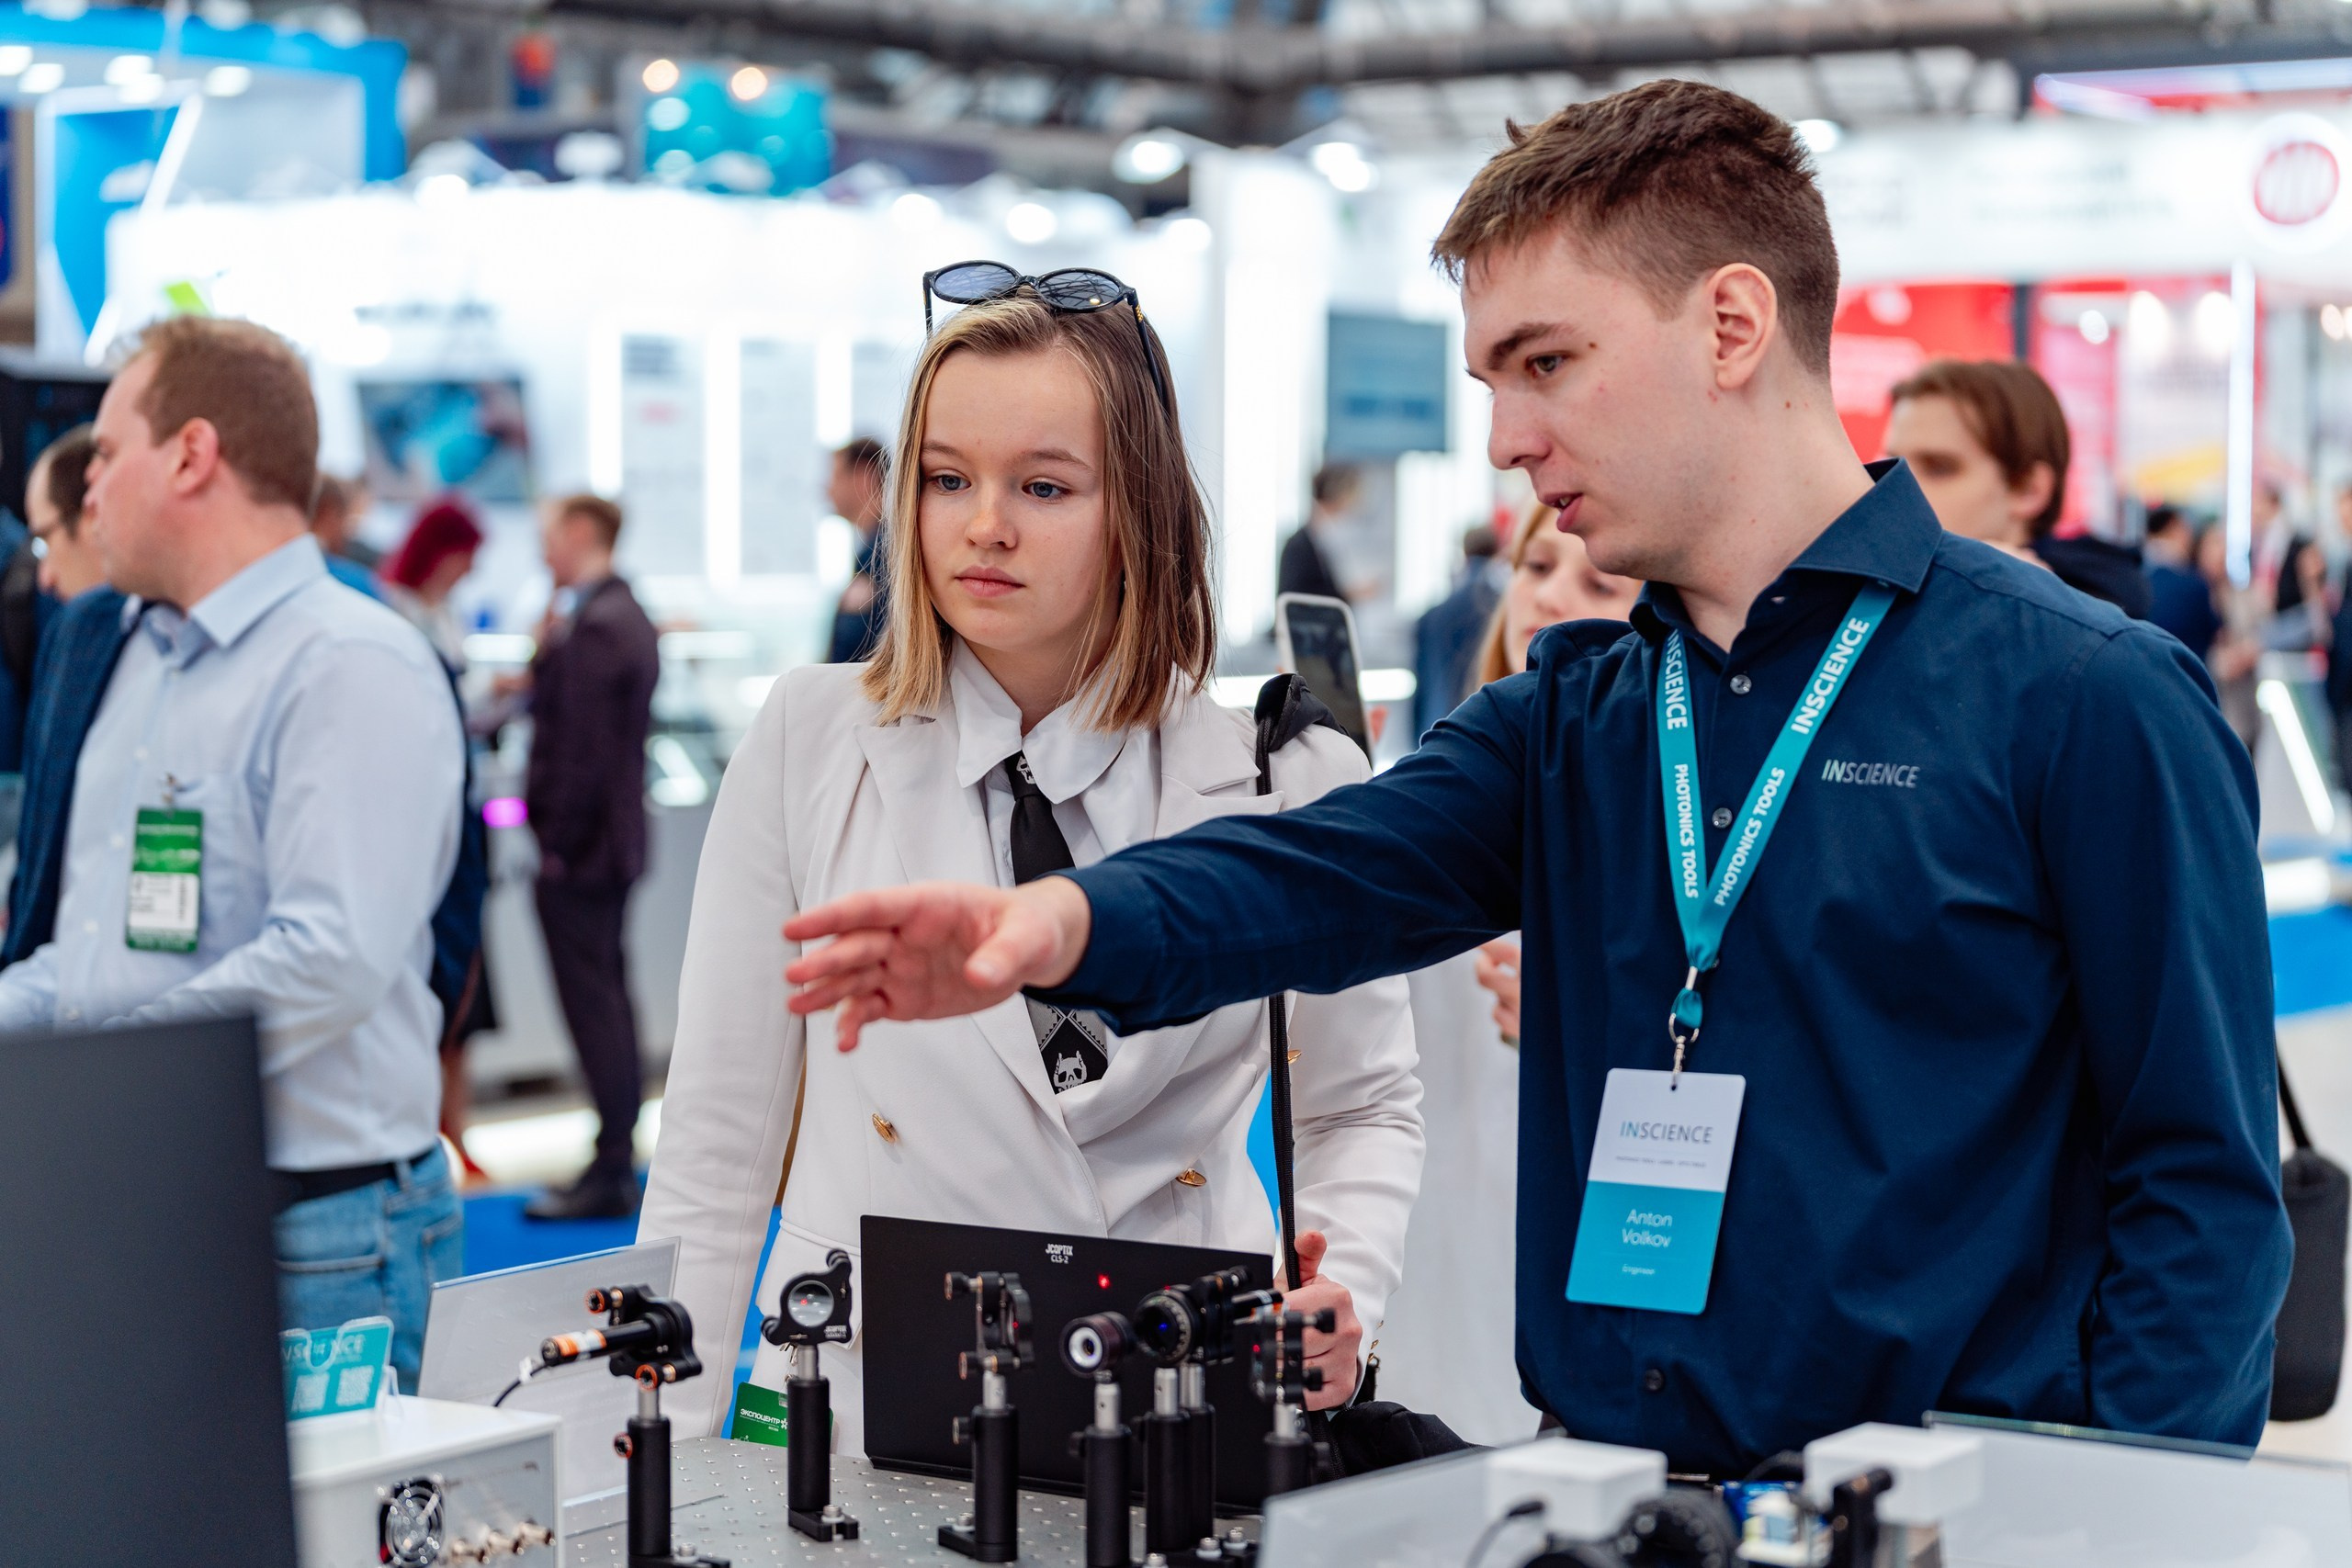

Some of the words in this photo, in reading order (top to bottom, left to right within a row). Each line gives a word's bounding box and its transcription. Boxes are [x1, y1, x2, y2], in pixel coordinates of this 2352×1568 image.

[1665, 628, 1688, 730] INSCIENCE
[1791, 617, 1871, 735] INSCIENCE
[1821, 759, 1921, 789] INSCIENCE
[1674, 763, 1695, 847] PHOTONICS
[1713, 817, 1763, 907] PHOTONICS
[1752, 766, 1786, 817] TOOLS
[1681, 849, 1699, 898] TOOLS
[1620, 1121, 1713, 1144] INSCIENCE
[1626, 1208, 1673, 1227] Anton
[1045, 1243, 1073, 1257] JCOPTIX
[1622, 1227, 1671, 1248] Volkov
[1050, 1254, 1069, 1264] CLS-2
[740, 1408, 781, 1425] ЭКСПОЦЕНТР
